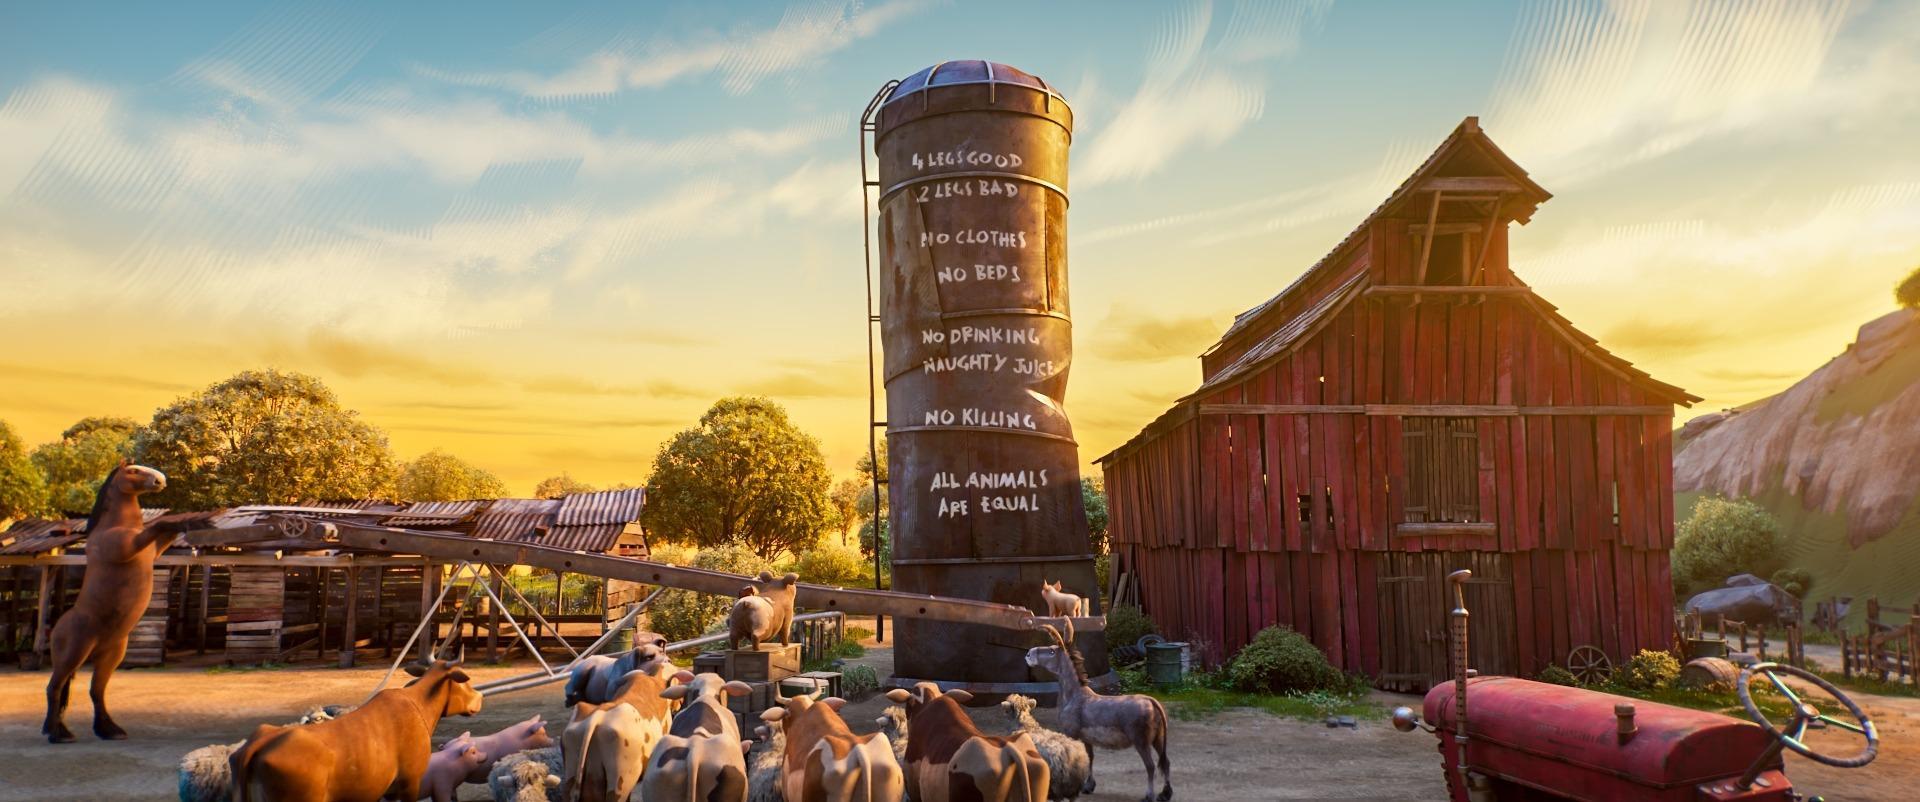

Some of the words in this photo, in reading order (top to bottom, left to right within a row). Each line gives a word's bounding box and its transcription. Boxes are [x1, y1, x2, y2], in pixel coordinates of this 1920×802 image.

[912, 152, 924, 170] 4
[928, 151, 964, 167] LEGS
[966, 151, 1023, 168] GOOD
[916, 186, 929, 203] 2
[935, 181, 973, 198] LEGS
[978, 179, 1019, 198] BAD
[920, 231, 950, 248] NO
[955, 229, 1027, 249] CLOTHES
[937, 266, 967, 284] NO
[974, 264, 1021, 283] BEDS
[922, 328, 945, 344] NO
[950, 326, 1041, 345] DRINKING
[923, 353, 1008, 375] NAUGHTY
[1013, 358, 1055, 377] JUICE
[925, 409, 955, 426] NO
[962, 408, 1036, 430] KILLING
[930, 471, 961, 492] ALL
[965, 469, 1048, 489] ANIMALS
[938, 497, 968, 519] ARE
[980, 493, 1040, 513] EQUAL
